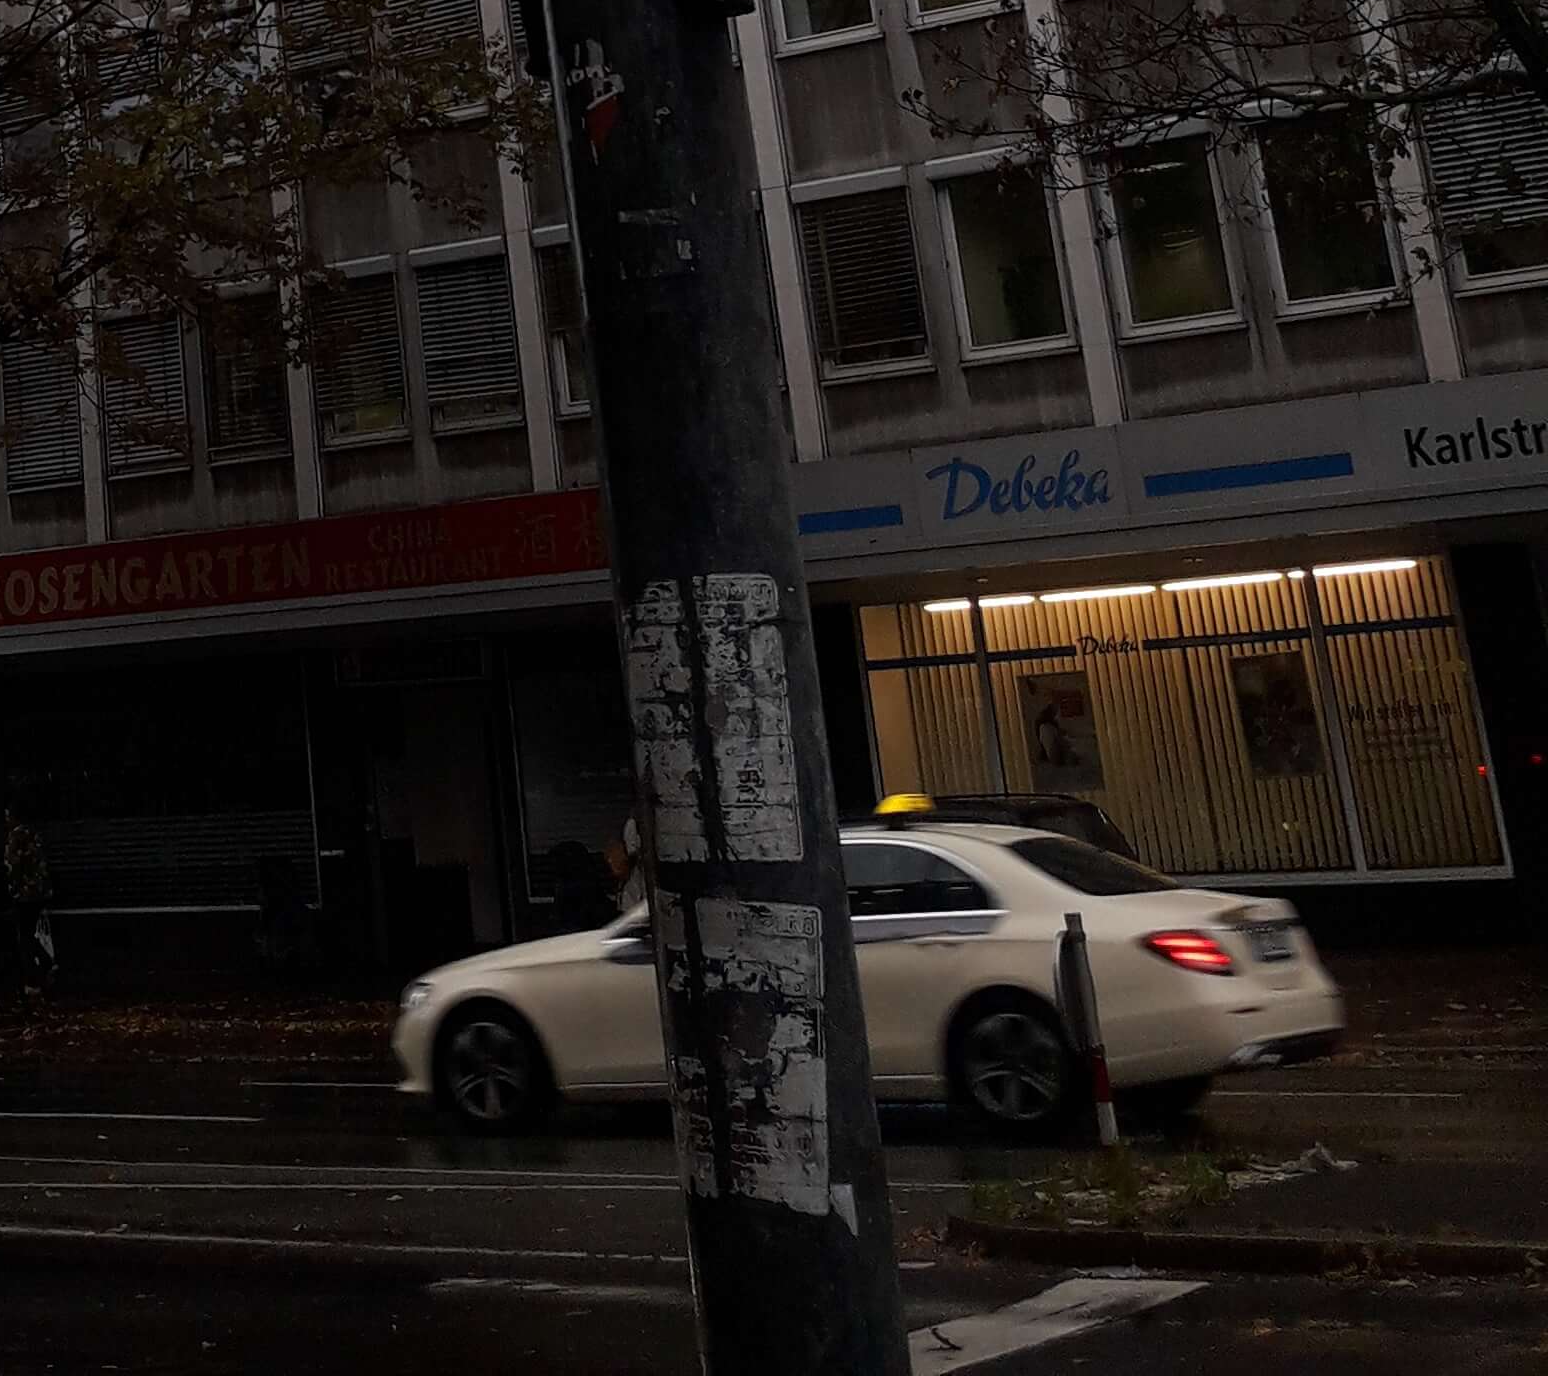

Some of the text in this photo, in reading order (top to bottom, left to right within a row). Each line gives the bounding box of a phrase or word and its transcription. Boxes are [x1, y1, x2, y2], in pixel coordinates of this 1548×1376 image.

[925, 449, 1110, 520] Debeka
[367, 517, 452, 553] CHINA
[323, 547, 502, 594] RESTAURANT
